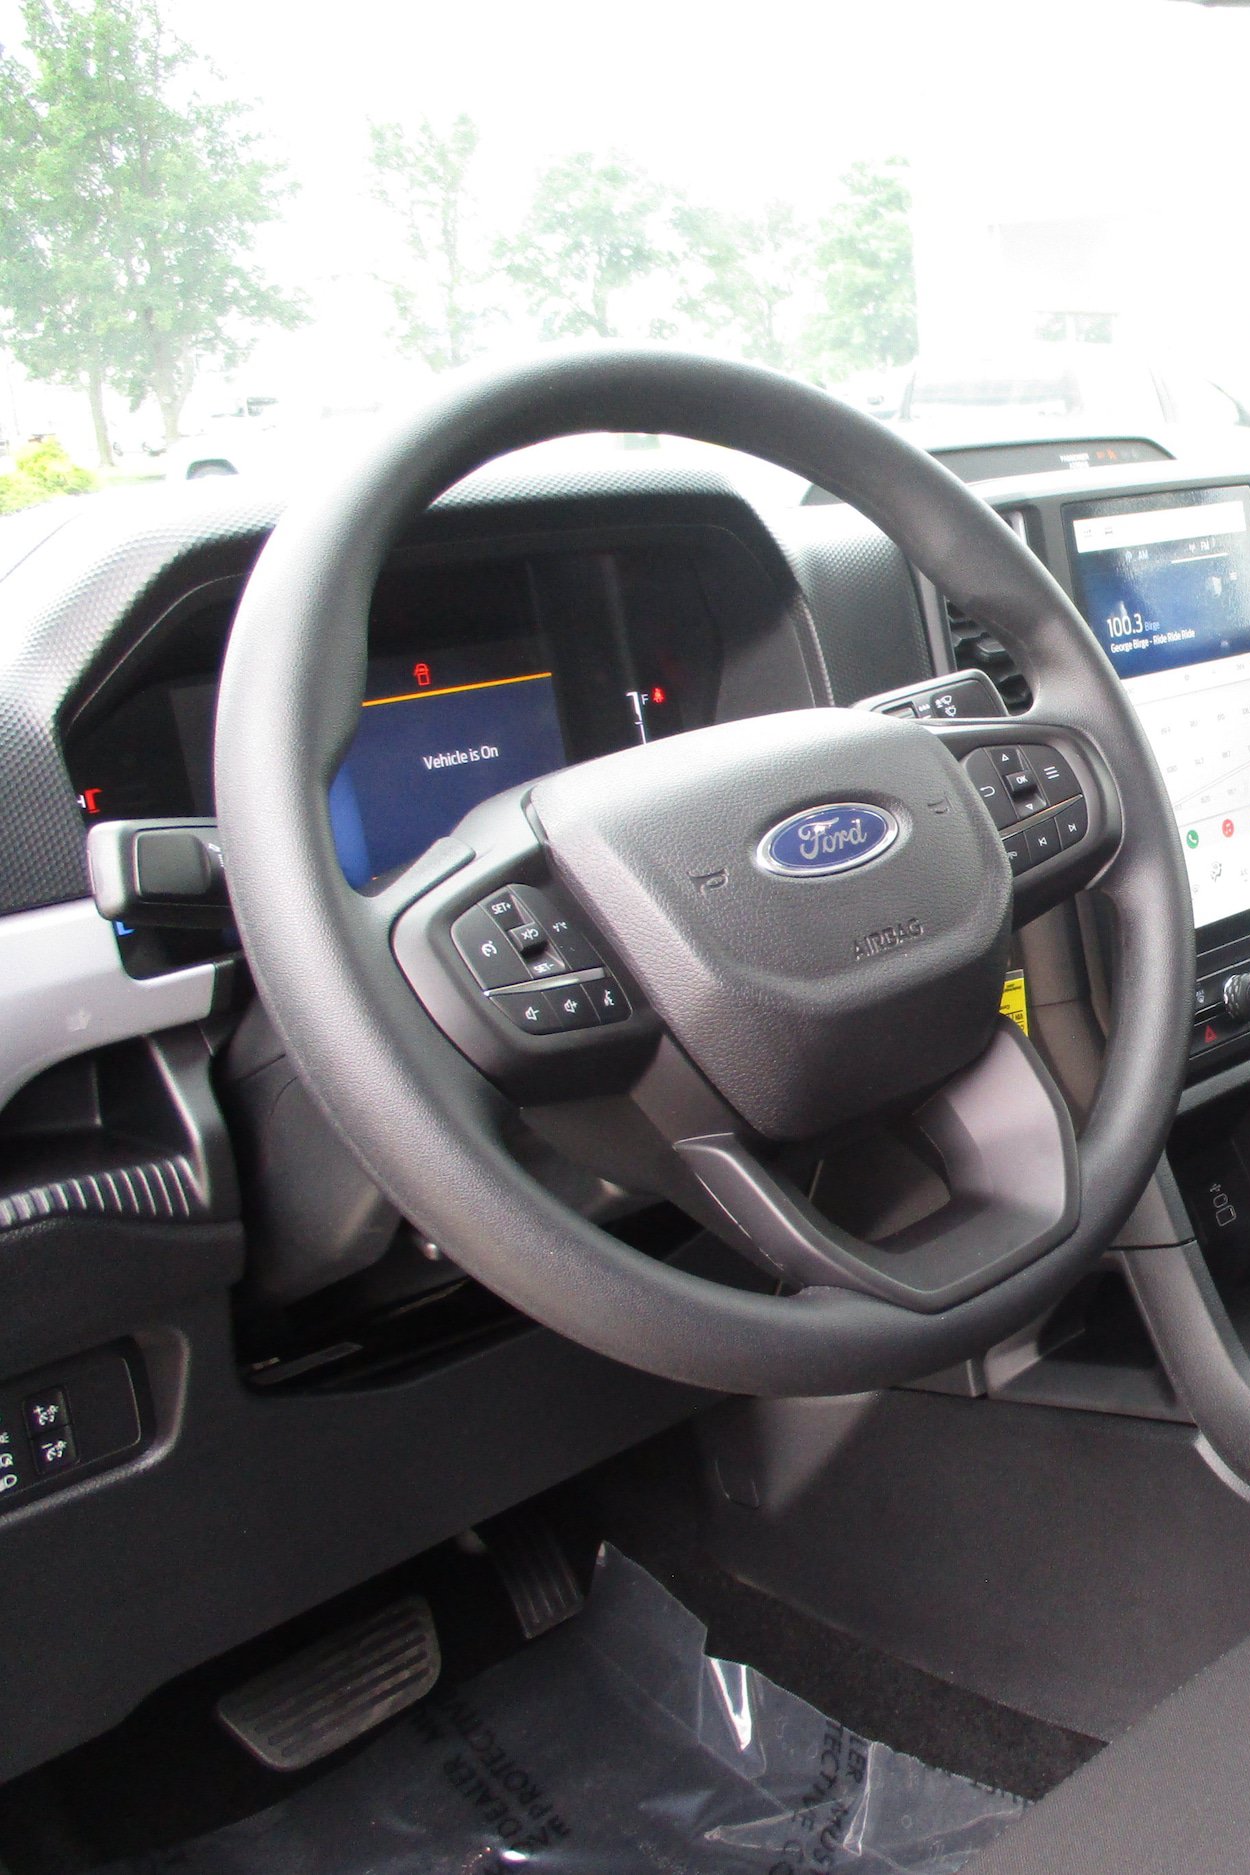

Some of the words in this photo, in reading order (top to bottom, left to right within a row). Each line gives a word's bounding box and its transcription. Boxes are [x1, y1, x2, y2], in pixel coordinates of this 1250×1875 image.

[1138, 550, 1148, 560] AM
[1200, 541, 1209, 551] FM
[1106, 613, 1143, 638] 100.3
[1110, 639, 1133, 653] George
[1132, 636, 1149, 650] Birge
[1167, 631, 1181, 643] Ride
[1181, 628, 1196, 640] Ride
[641, 693, 649, 705] F
[423, 747, 469, 770] Vehicle
[470, 746, 480, 763] is
[480, 745, 499, 761] On
[1016, 775, 1028, 784] OK
[797, 816, 868, 861] Ford
[491, 902, 512, 915] SET+
[854, 917, 925, 961] AIRBAG
